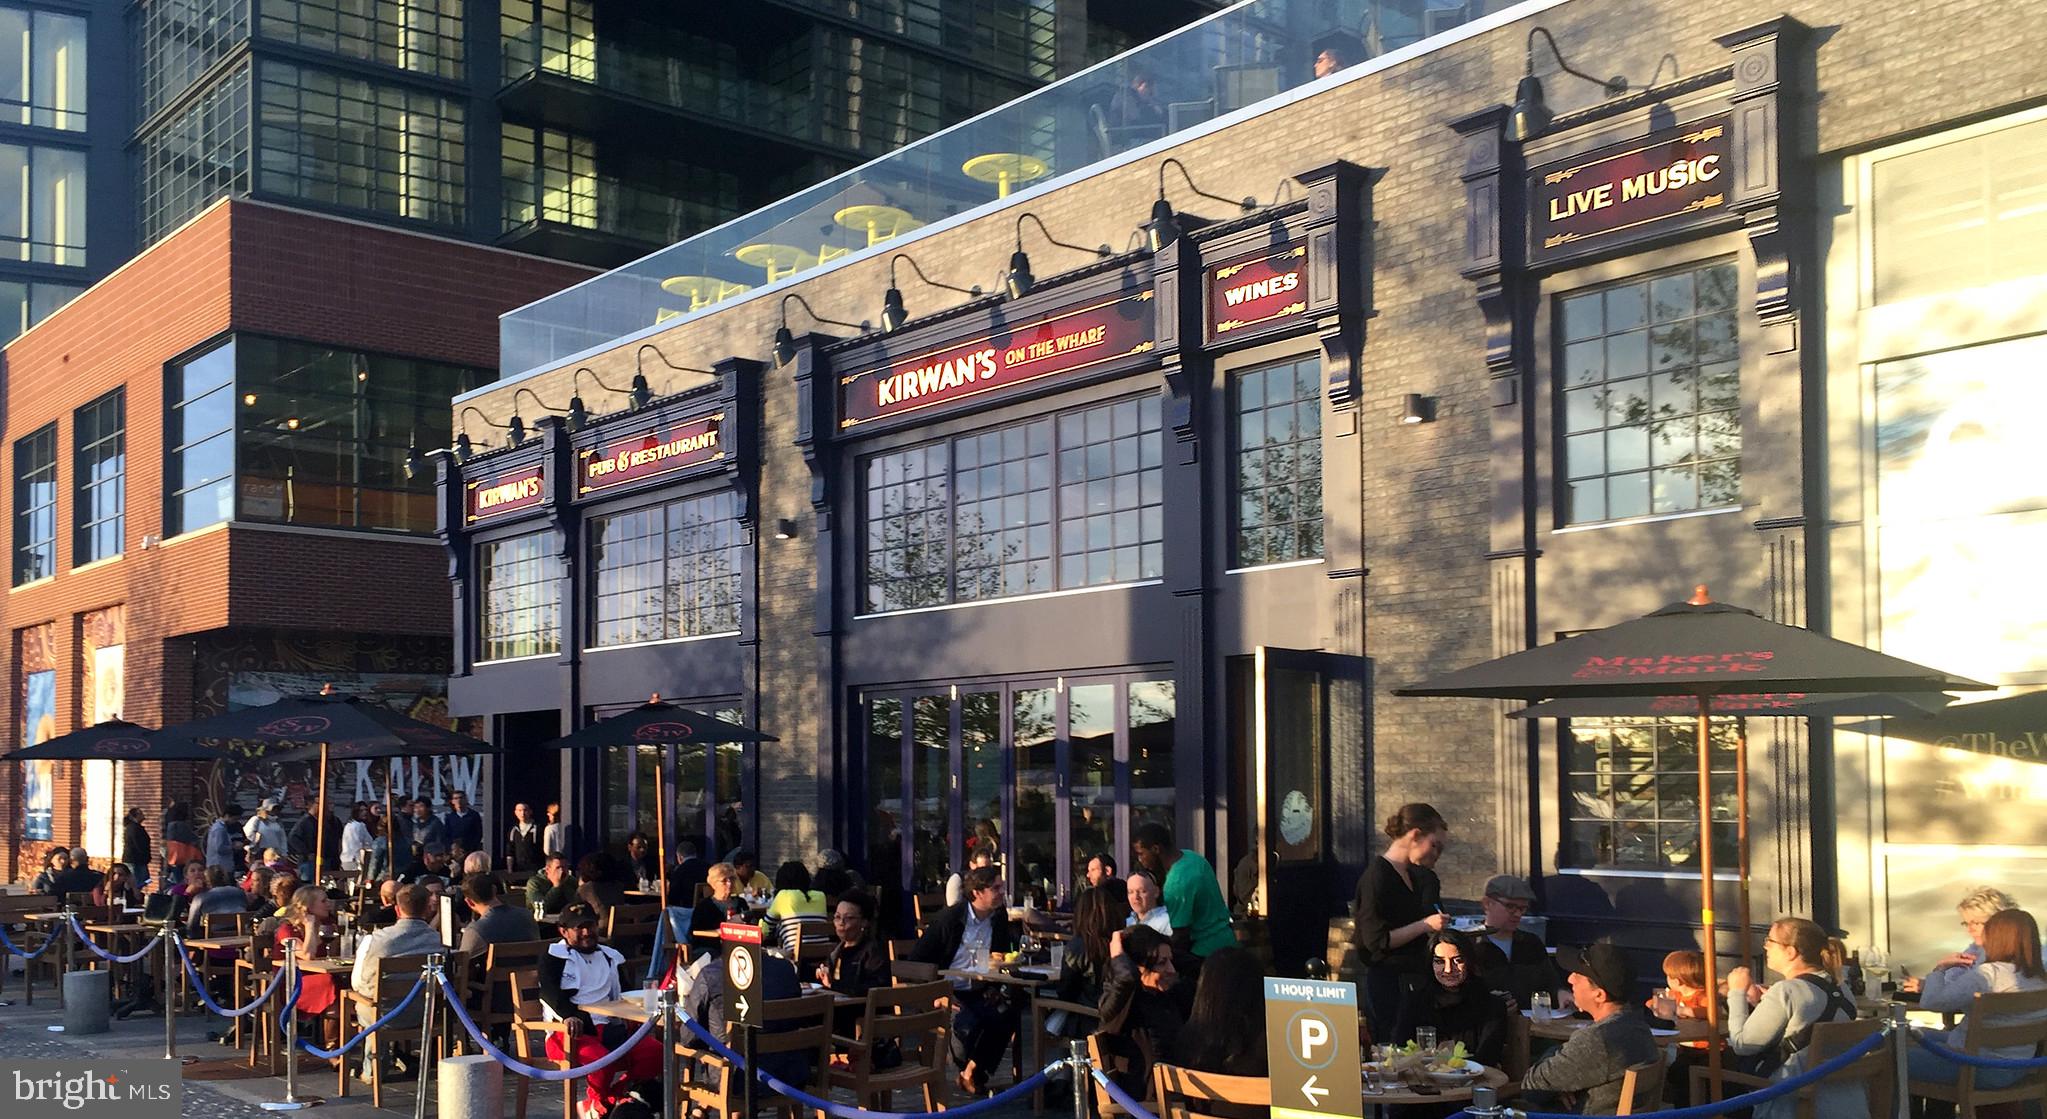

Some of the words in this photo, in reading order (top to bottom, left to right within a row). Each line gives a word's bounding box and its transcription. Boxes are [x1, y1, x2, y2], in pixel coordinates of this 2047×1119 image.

[1550, 183, 1614, 221] LIVE
[1621, 155, 1720, 202] MUSIC
[1224, 272, 1299, 306] WINES
[877, 350, 997, 407] KIRWAN'S
[1005, 349, 1025, 365] ON
[1029, 342, 1055, 359] THE
[1056, 325, 1106, 351] WHARF
[589, 459, 616, 478] PUB
[630, 430, 719, 467] RESTAURANT
[479, 476, 539, 509] KIRWAN'S
[1586, 650, 1774, 667] Maker's
[1628, 662, 1768, 675] Mark
[1274, 984, 1280, 994] 1
[1280, 984, 1314, 996] HOUR
[1317, 987, 1346, 999] LIMIT
[1301, 1019, 1329, 1059] P
